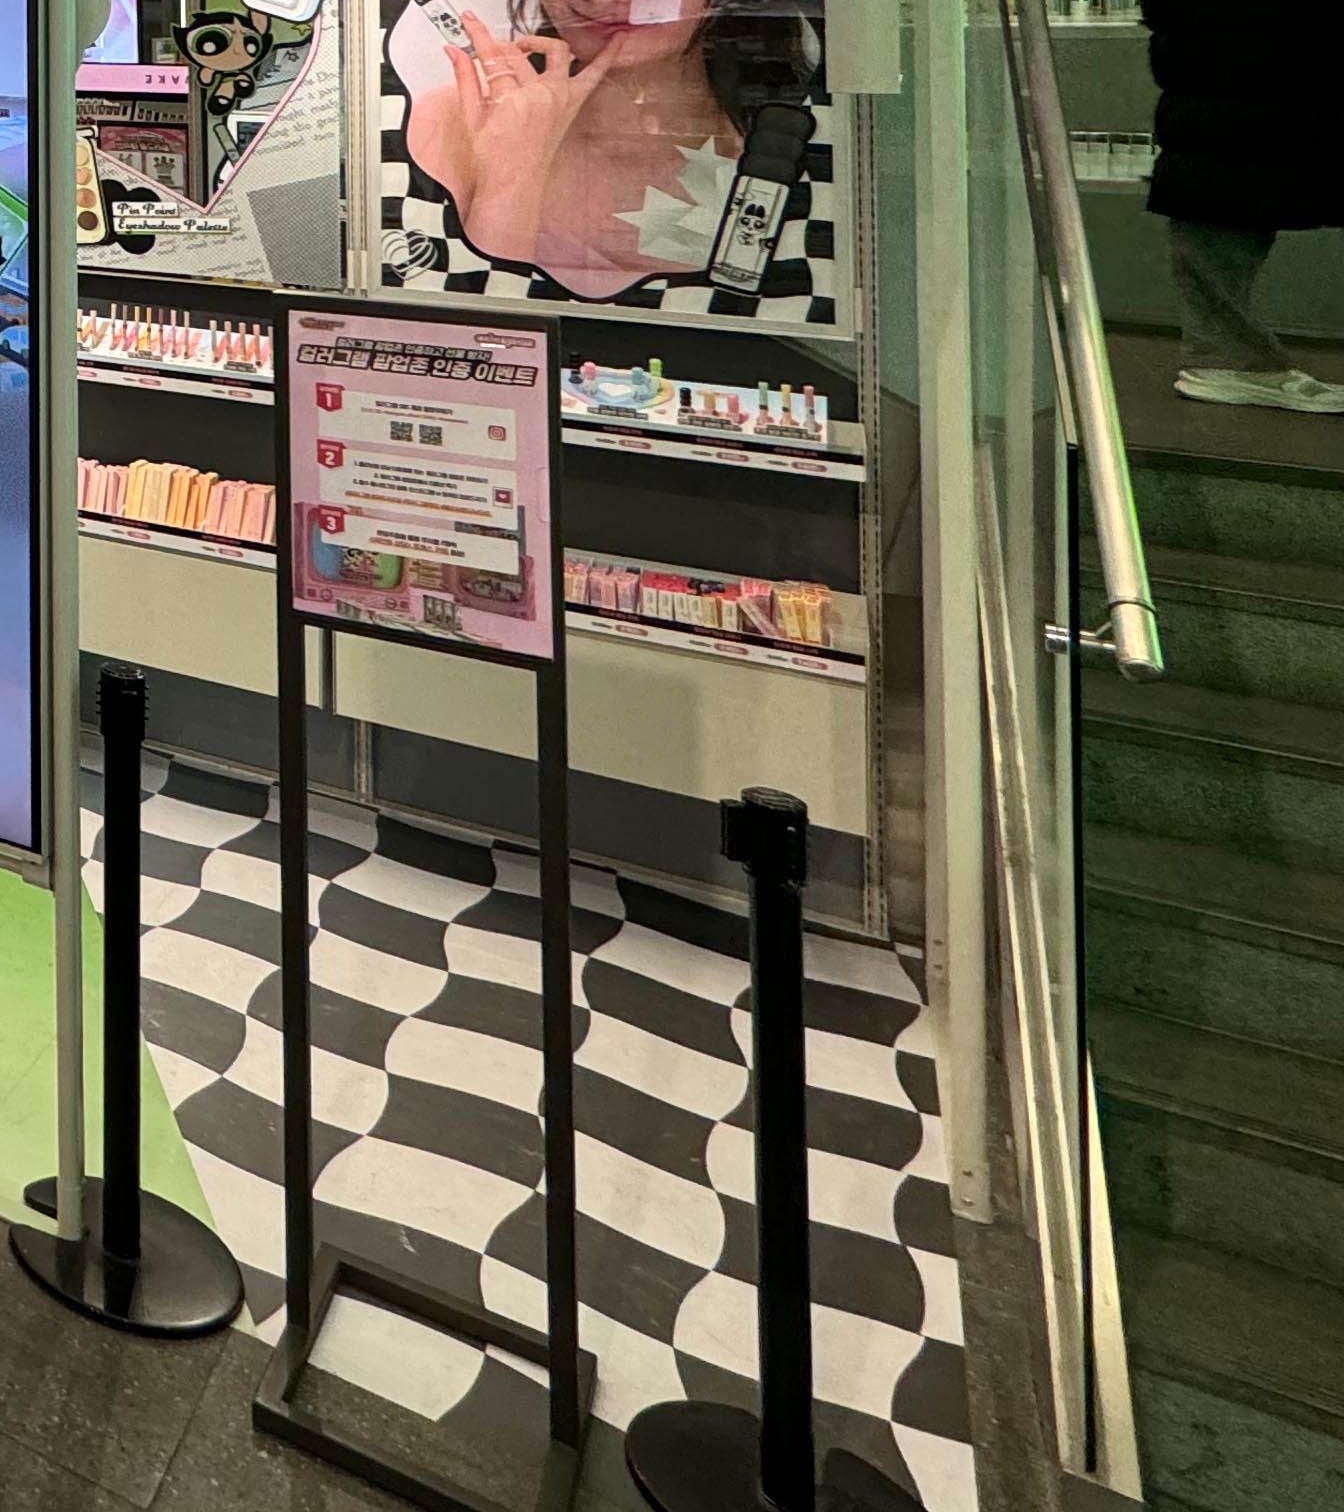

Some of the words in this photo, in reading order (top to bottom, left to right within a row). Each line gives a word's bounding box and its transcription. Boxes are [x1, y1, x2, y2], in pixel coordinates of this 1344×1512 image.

[116, 203, 140, 215] Pin
[143, 202, 175, 215] Point
[117, 218, 181, 232] Eyeshadow
[183, 219, 229, 232] Palette
[300, 346, 369, 369] 컬러그램
[372, 353, 429, 375] 팝업존
[433, 359, 471, 380] 인증
[475, 365, 537, 386] 이벤트
[324, 393, 332, 408] 1
[325, 451, 336, 465] 2
[325, 518, 336, 530] 3
